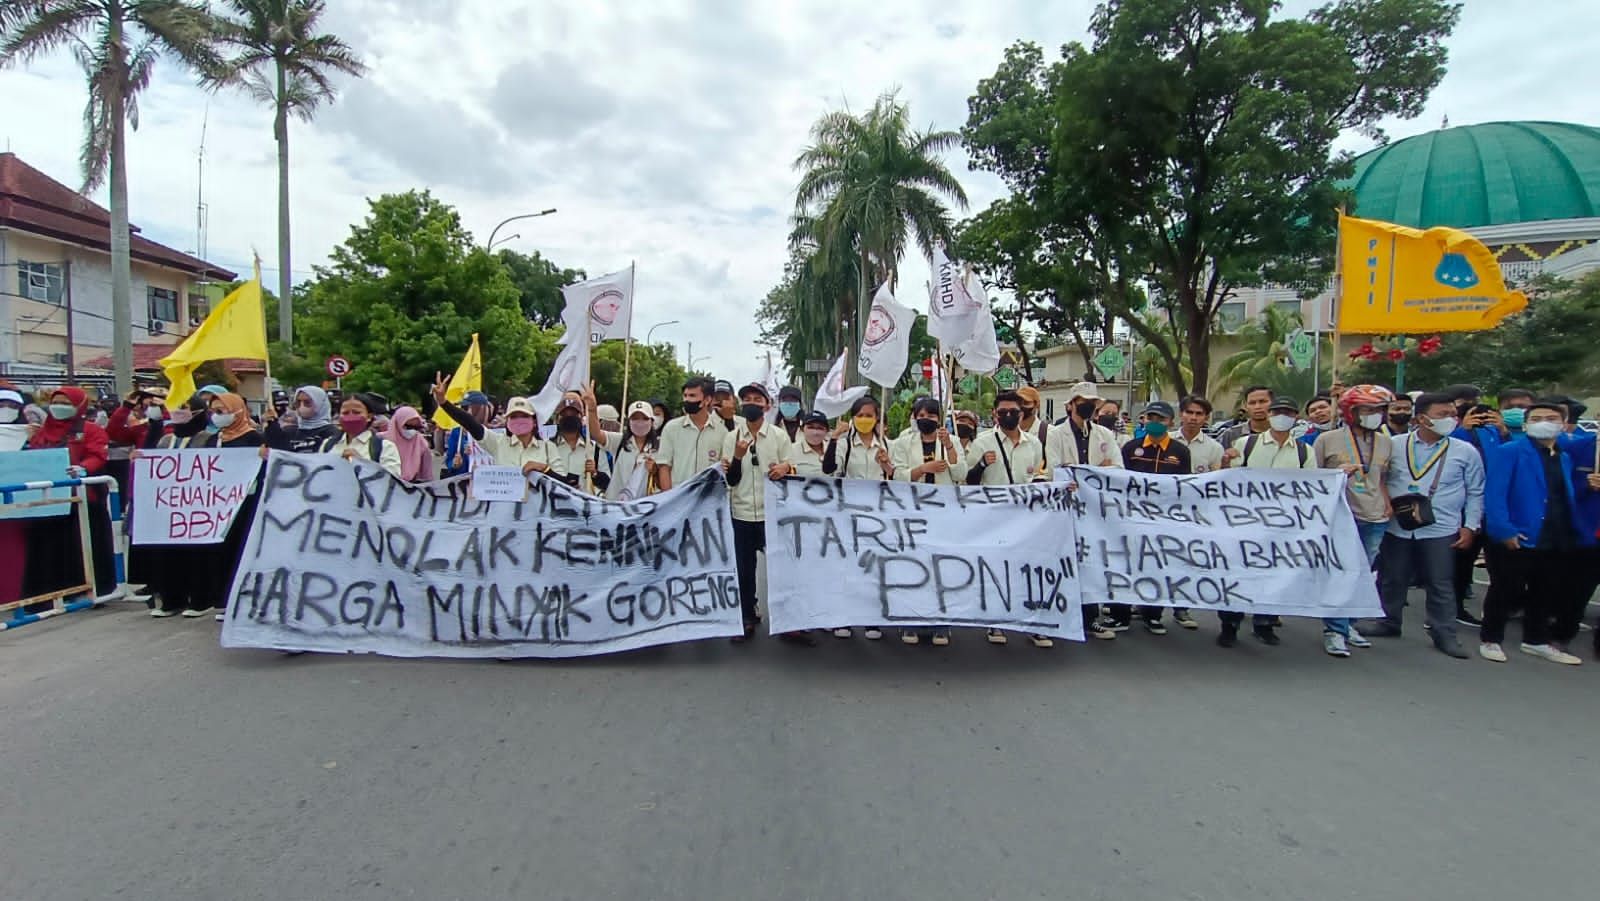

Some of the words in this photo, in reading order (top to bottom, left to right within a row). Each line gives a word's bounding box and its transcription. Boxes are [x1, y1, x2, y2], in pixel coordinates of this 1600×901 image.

[939, 261, 954, 310] KMHDI
[141, 453, 224, 482] TOLAK
[264, 459, 335, 503] PC
[1173, 475, 1330, 501] KENAIKAN
[168, 510, 232, 539] BBM
[1099, 493, 1211, 526] HARGA
[1220, 504, 1329, 530] BBM
[256, 510, 519, 576] MENOLAK
[776, 514, 928, 557] TARIF
[1100, 534, 1229, 575] HARGA
[1241, 534, 1344, 572] BAHAN
[232, 567, 405, 629] HARGA
[606, 574, 740, 626] GORENG
[1104, 570, 1253, 606] POKOK
